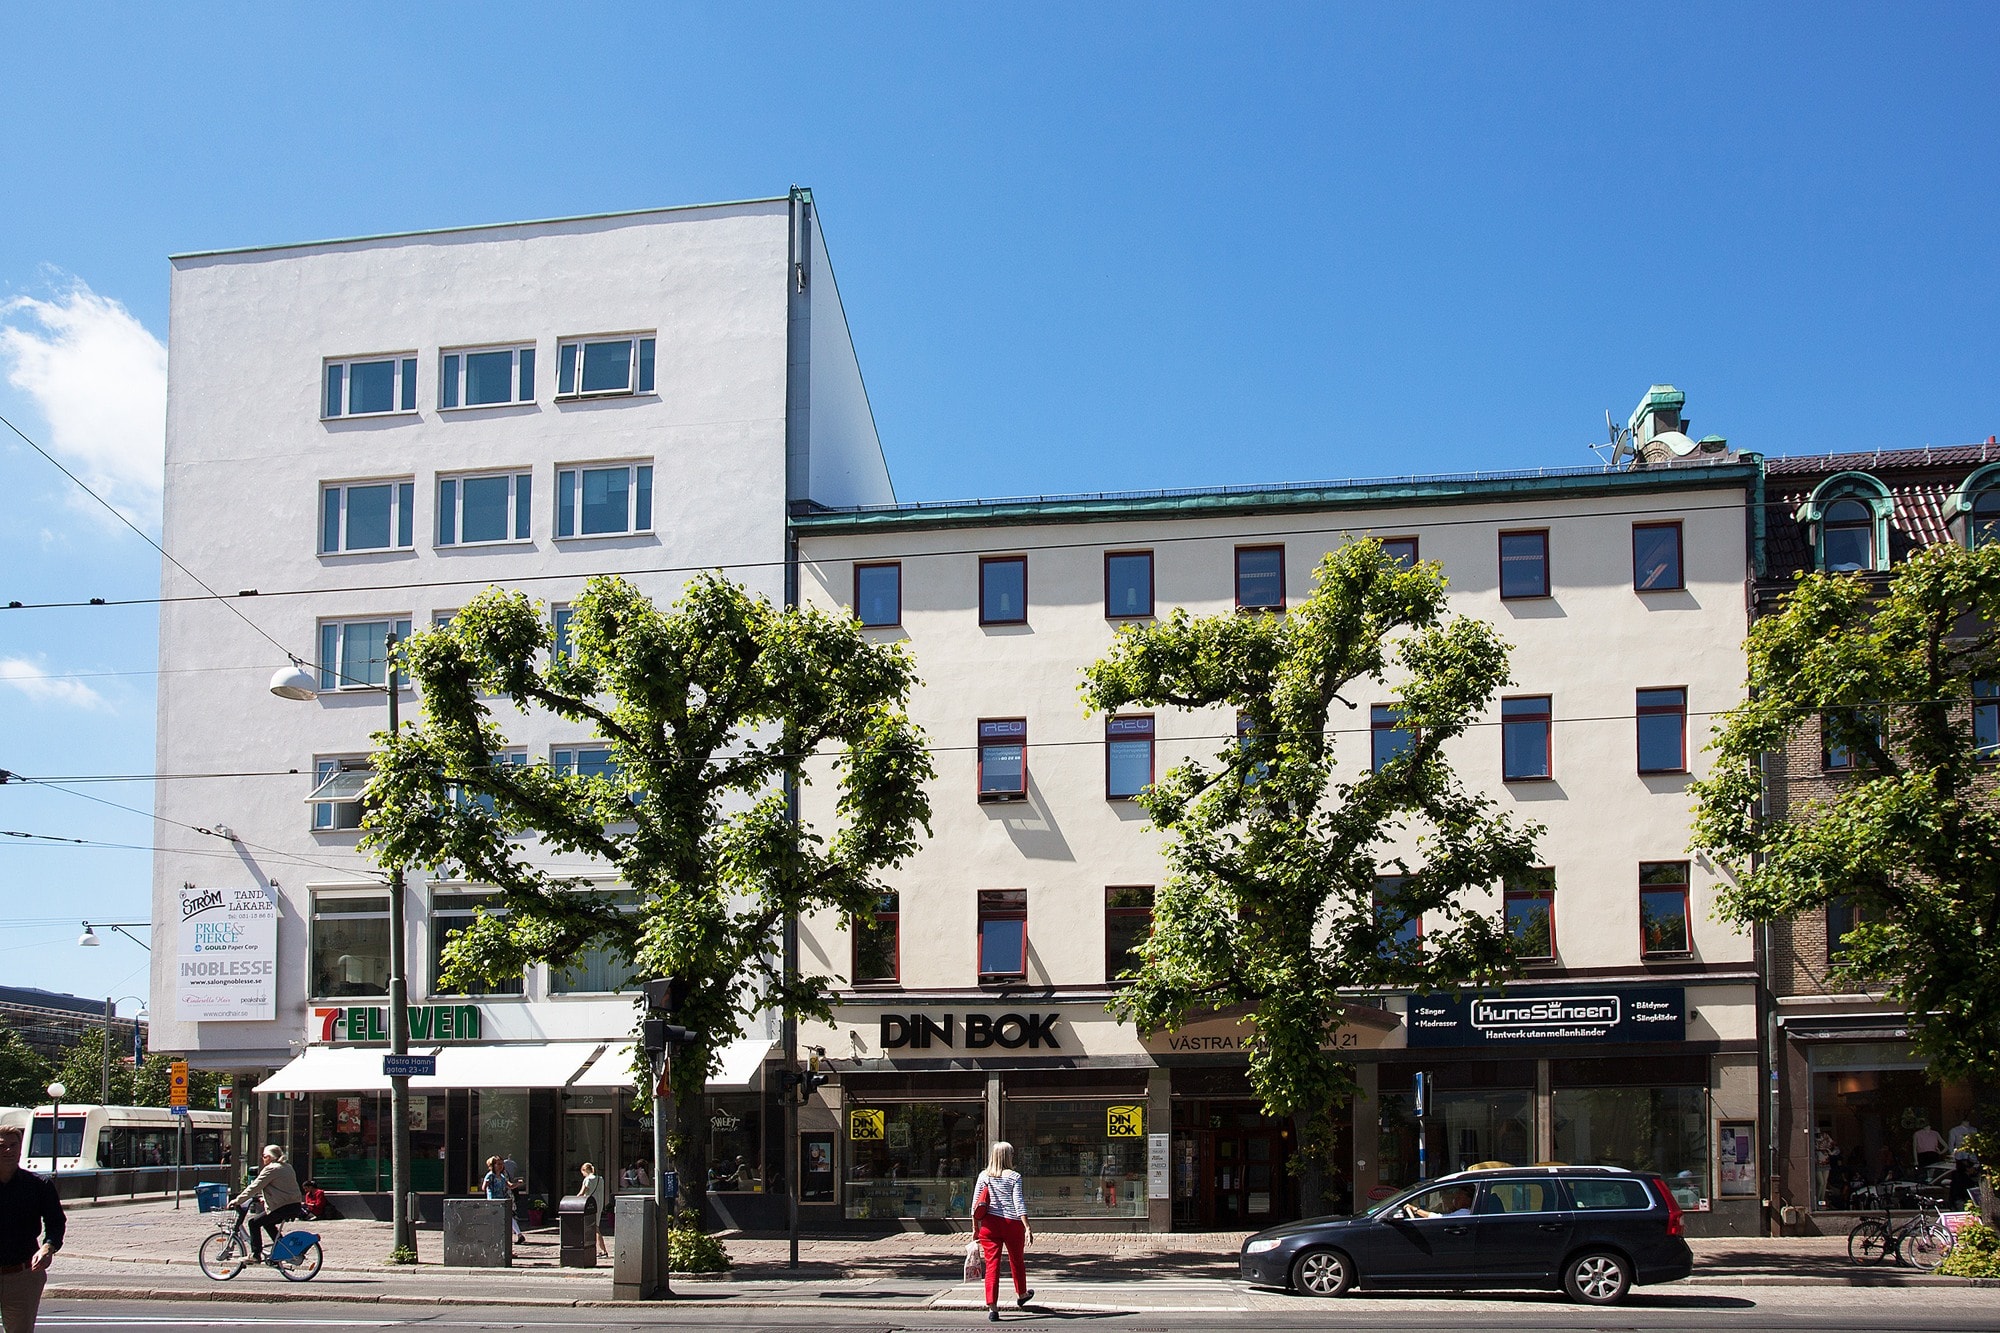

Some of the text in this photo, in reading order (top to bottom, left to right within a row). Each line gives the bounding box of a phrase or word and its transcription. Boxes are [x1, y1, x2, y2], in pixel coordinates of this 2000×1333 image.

[985, 722, 1021, 732] REQ
[234, 890, 268, 900] TAND-
[182, 890, 222, 915] STRÖM
[229, 900, 273, 911] LÄKARE
[195, 922, 231, 934] PRICE
[195, 933, 239, 943] PIERCE
[185, 961, 273, 976] NOBLESSE
[1636, 1001, 1670, 1010] Båtdynor
[1636, 1013, 1678, 1022] Sängkläder
[1420, 1020, 1458, 1028] Madrasser
[880, 1013, 1061, 1049] DIN BOK
[1486, 1028, 1607, 1039] Hantverk utan mellanhänder
[1169, 1036, 1234, 1050] VÄSTRA
[1342, 1034, 1358, 1047] 21
[387, 1057, 410, 1065] Västra
[583, 1096, 594, 1104] 23
[710, 1117, 740, 1128] SWEET
[853, 1118, 873, 1127] DIN
[1110, 1115, 1131, 1124] DIN
[853, 1128, 878, 1138] BOK
[1110, 1125, 1136, 1135] BOK
